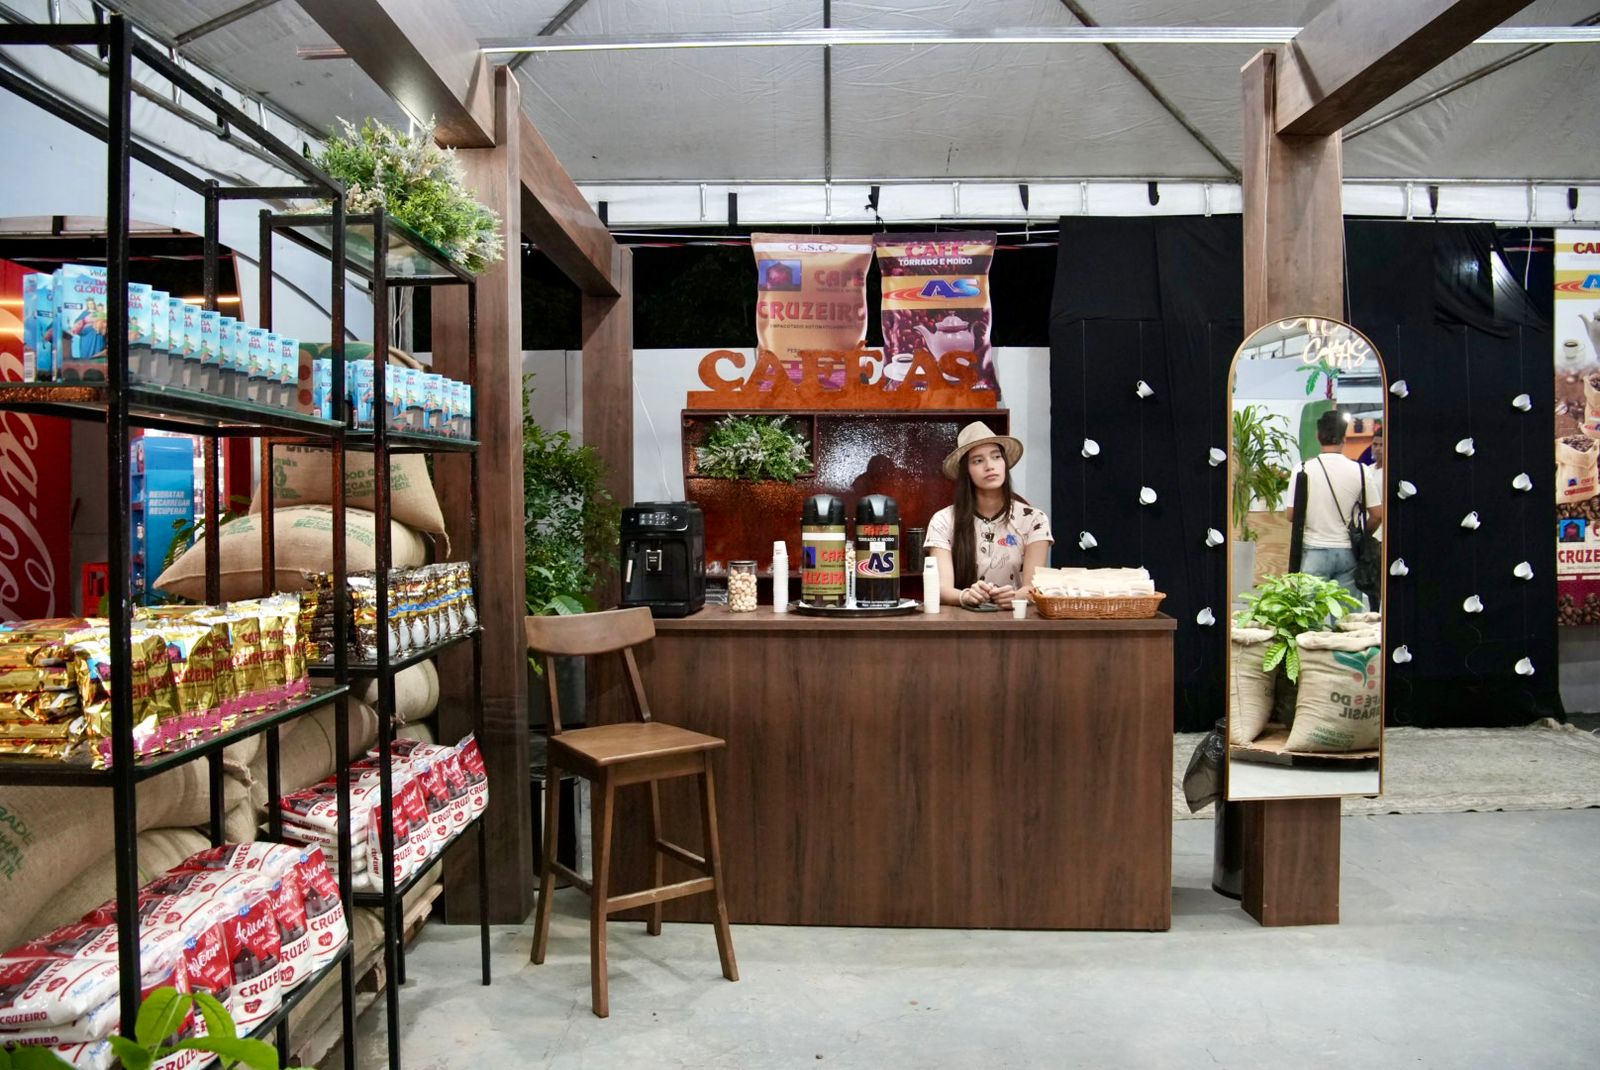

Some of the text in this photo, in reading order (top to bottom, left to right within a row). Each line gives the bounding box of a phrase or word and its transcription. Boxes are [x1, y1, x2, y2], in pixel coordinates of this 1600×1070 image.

[898, 257, 938, 266] TORRADO
[920, 278, 981, 299] AS
[757, 300, 866, 322] CRUZEIRO
[868, 552, 894, 572] AS
